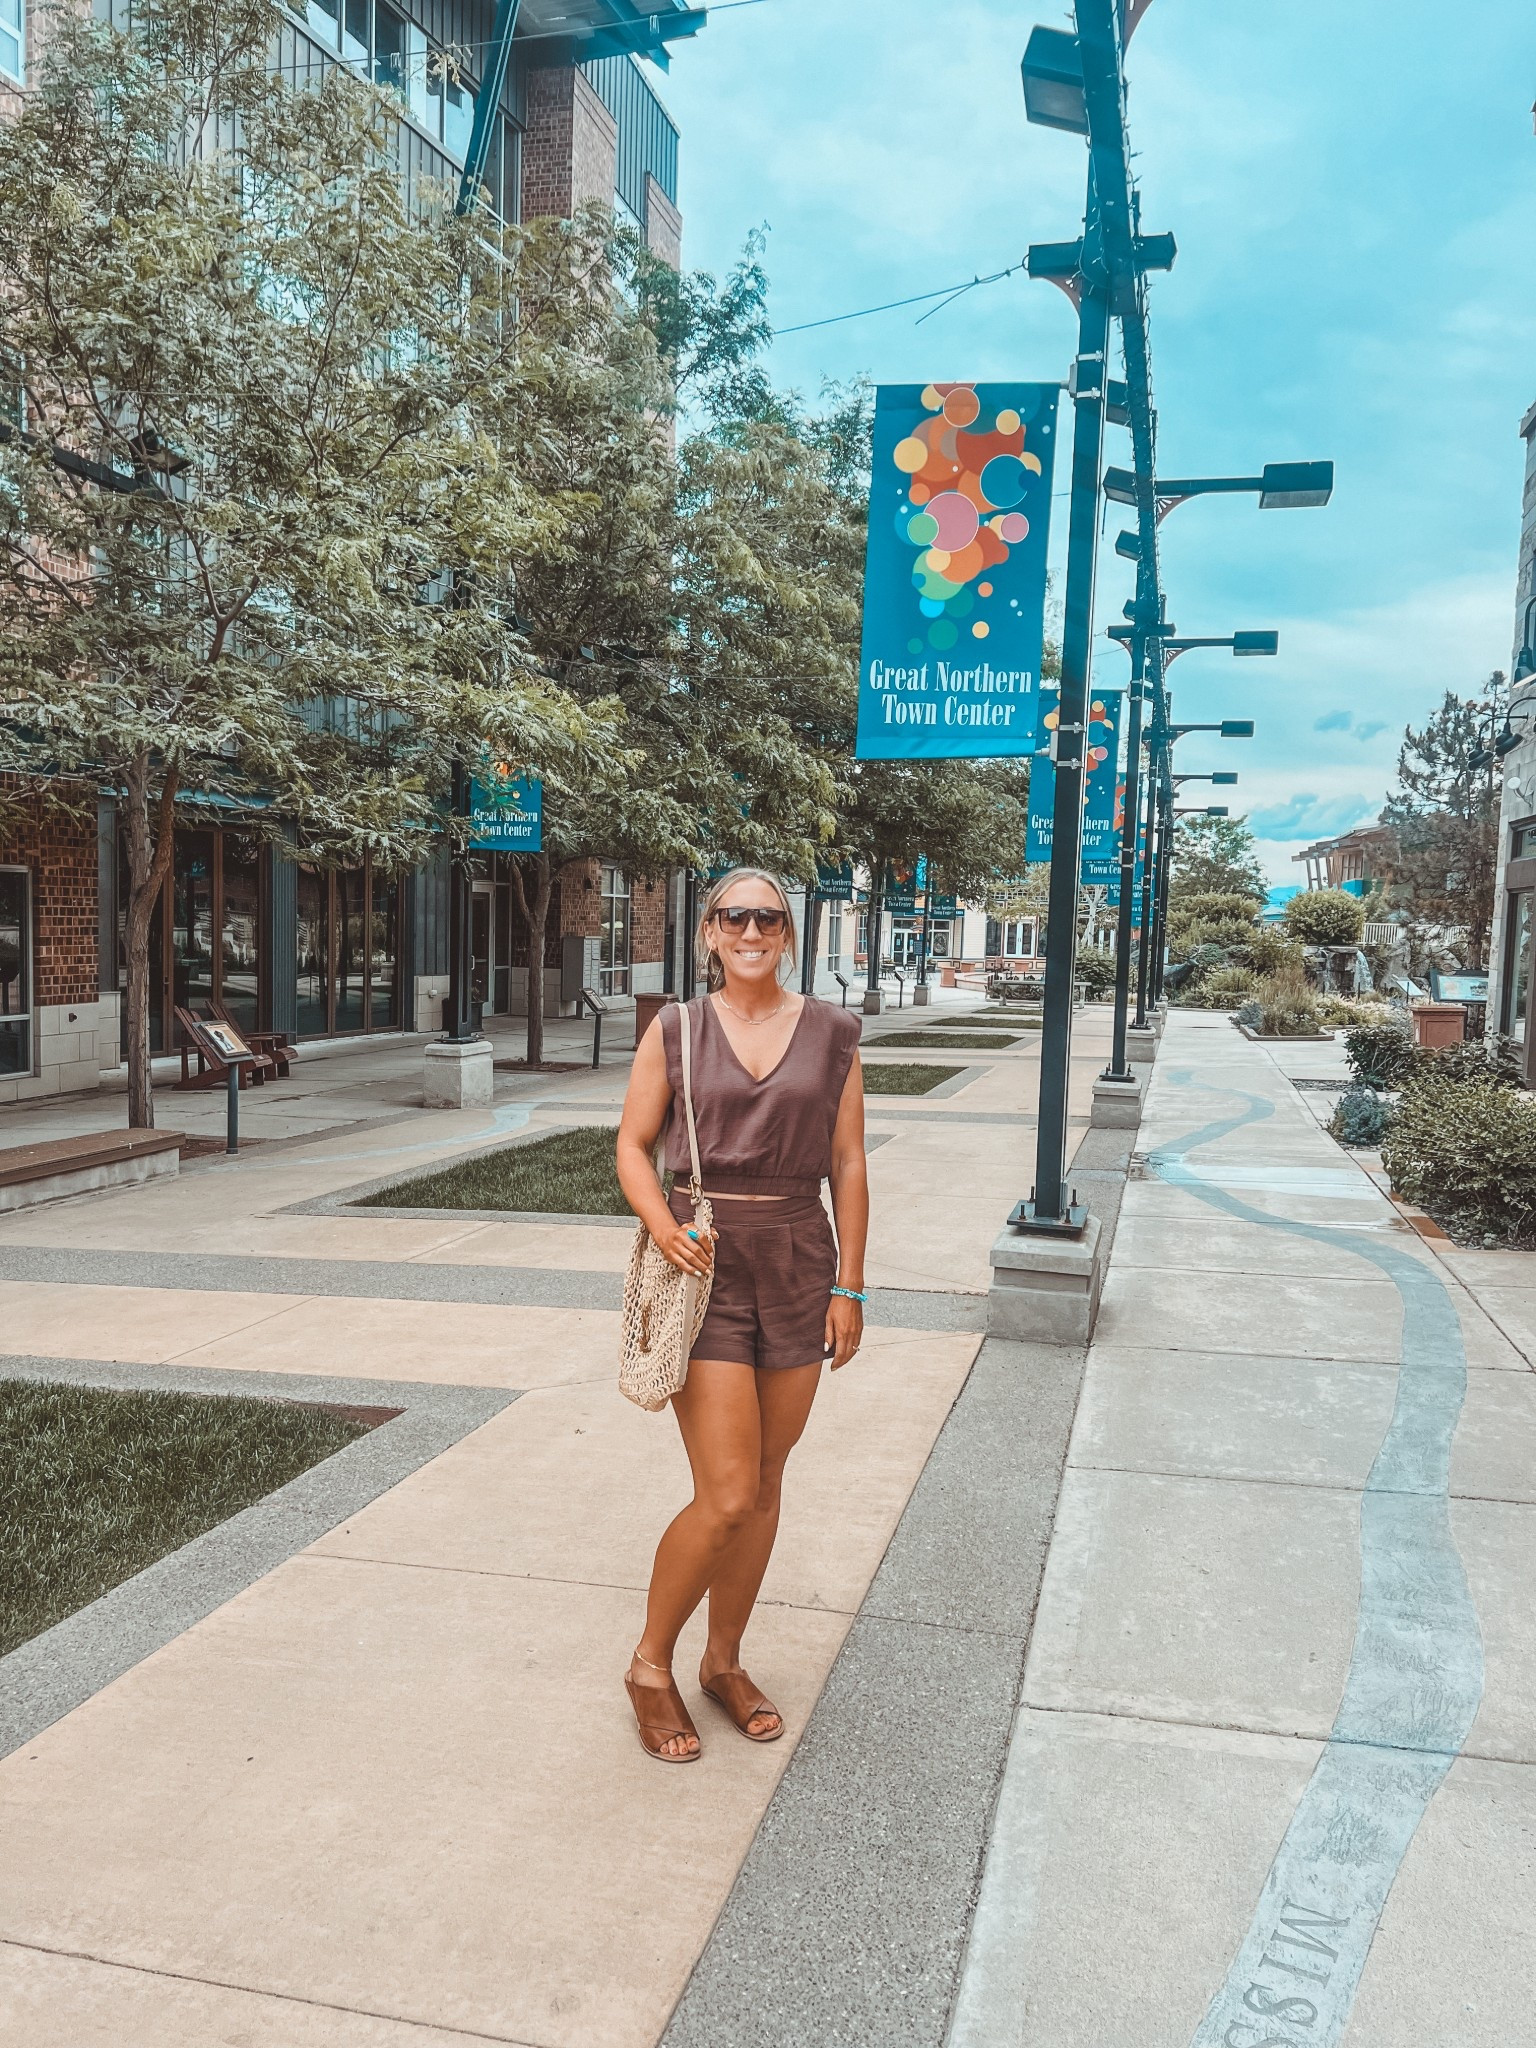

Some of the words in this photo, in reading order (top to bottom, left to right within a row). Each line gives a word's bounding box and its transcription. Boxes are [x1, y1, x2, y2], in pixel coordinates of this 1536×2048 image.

[869, 659, 929, 691] Great
[934, 661, 1032, 693] Northern
[881, 693, 937, 725] Town
[944, 695, 1016, 726] Center
[1031, 814, 1054, 829] Grea
[503, 822, 532, 837] Center
[1037, 830, 1053, 845] To
[1089, 863, 1108, 874] Town
[1109, 863, 1121, 875] Cen
